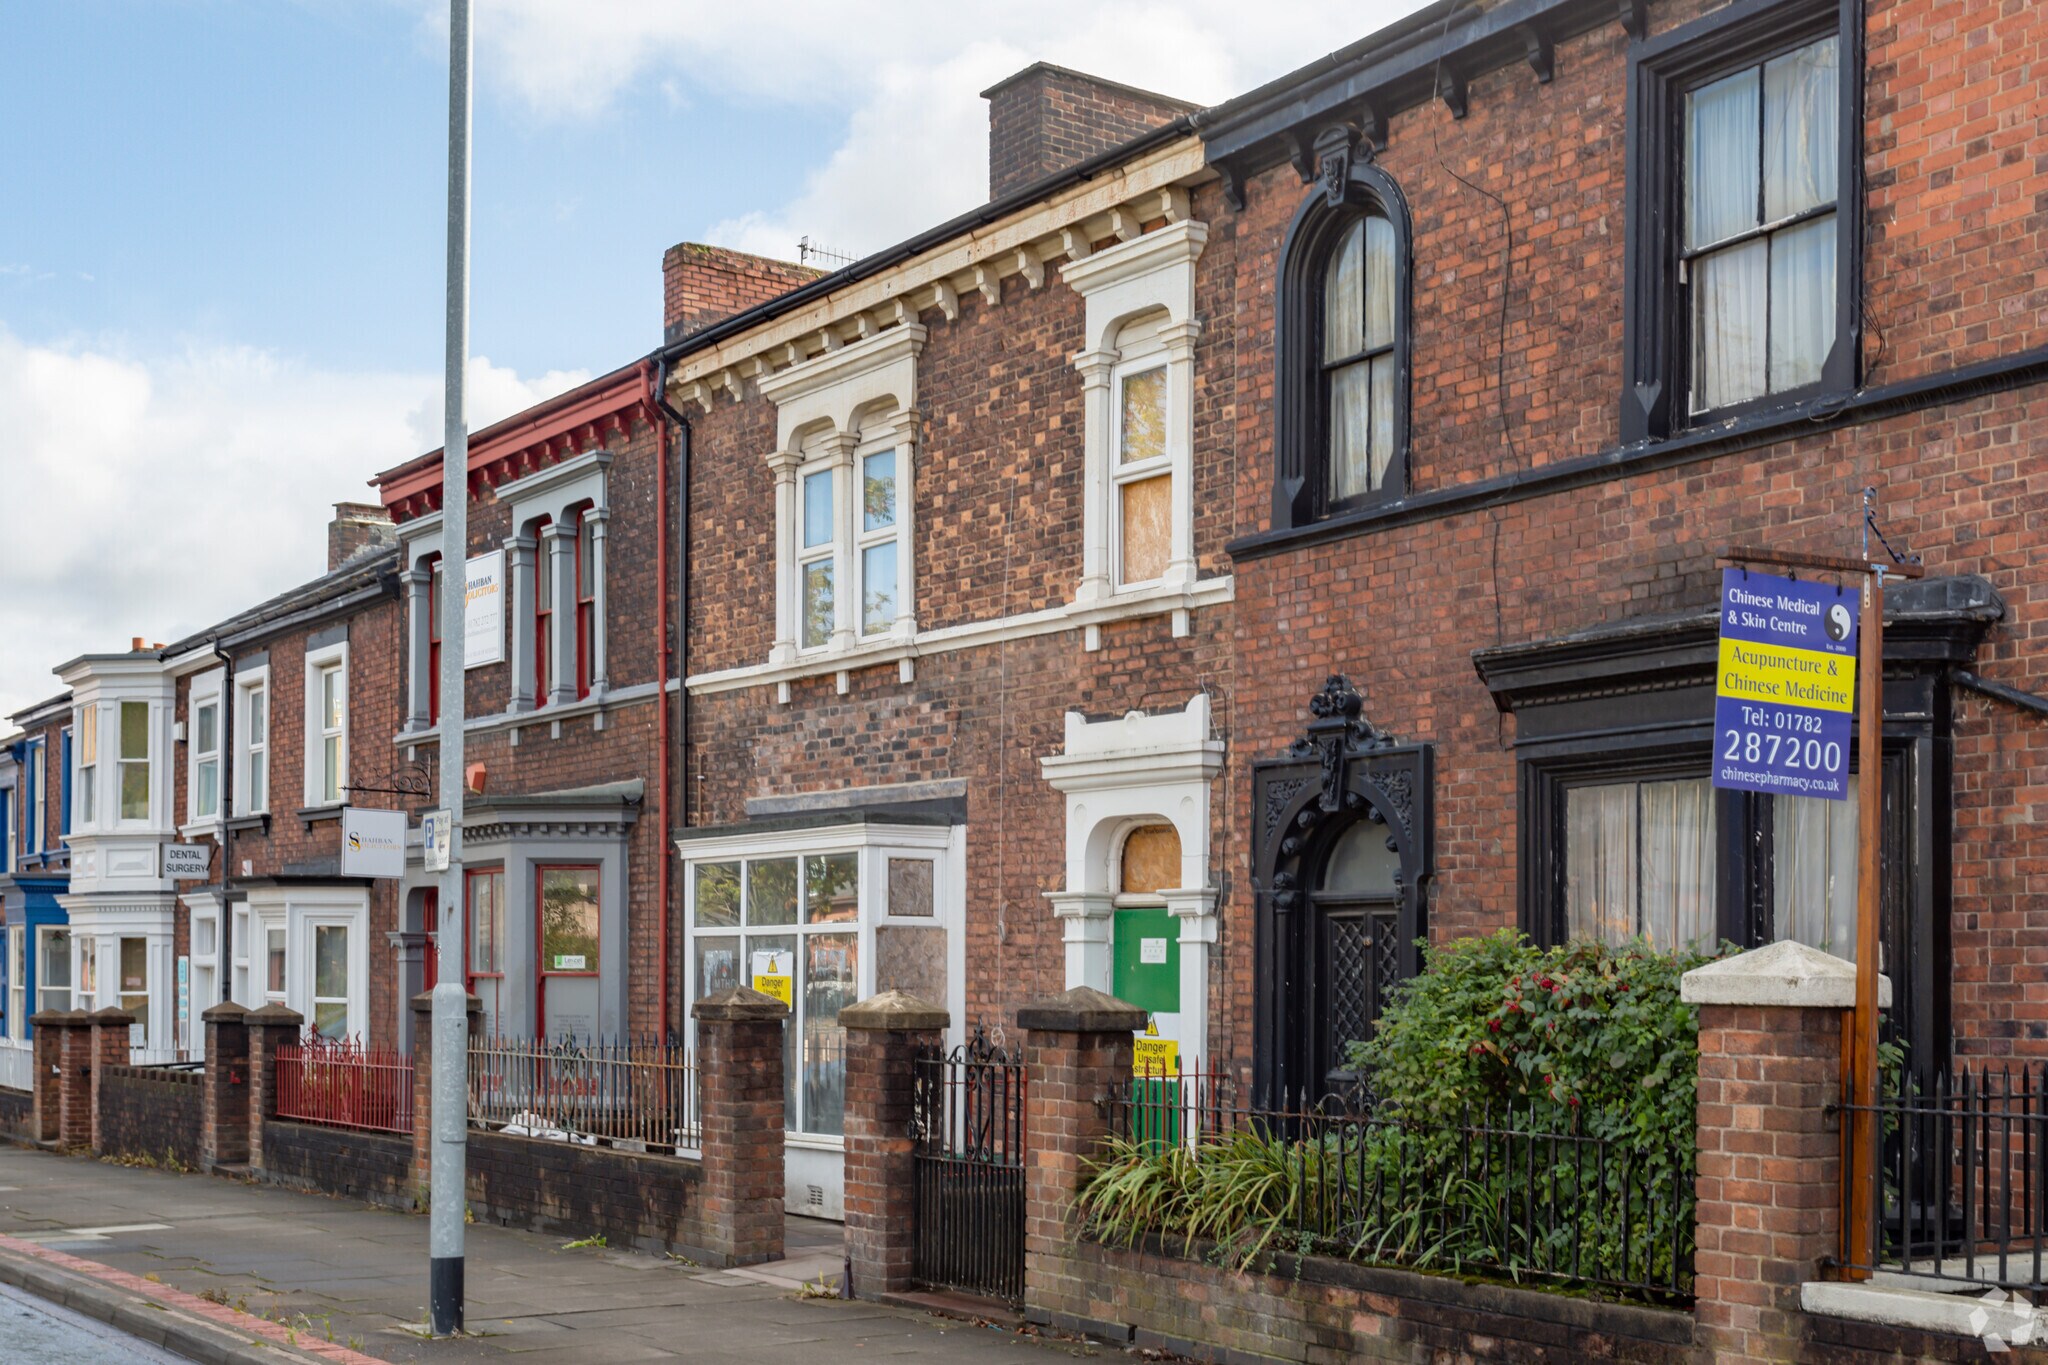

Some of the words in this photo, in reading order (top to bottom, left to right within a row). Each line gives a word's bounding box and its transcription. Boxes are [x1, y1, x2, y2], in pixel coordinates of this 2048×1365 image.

[1729, 588, 1773, 609] Chinese
[1777, 595, 1820, 615] Medical
[1727, 610, 1738, 625] &
[1741, 612, 1766, 629] Skin
[1770, 616, 1807, 635] Centre
[1732, 646, 1821, 674] Acupuncture
[1827, 660, 1838, 676] &
[1725, 672, 1779, 695] Chinese
[1785, 681, 1847, 704] Medicine
[1742, 706, 1769, 727] Tel:
[1775, 712, 1821, 734] 01782
[1724, 730, 1841, 772] 287200
[1721, 766, 1839, 791] chinesepharmacy.co.uk
[170, 850, 202, 859] DENTAL
[166, 863, 206, 873] SURGERY
[762, 977, 784, 989] Danger
[1136, 1040, 1167, 1055] Danger
